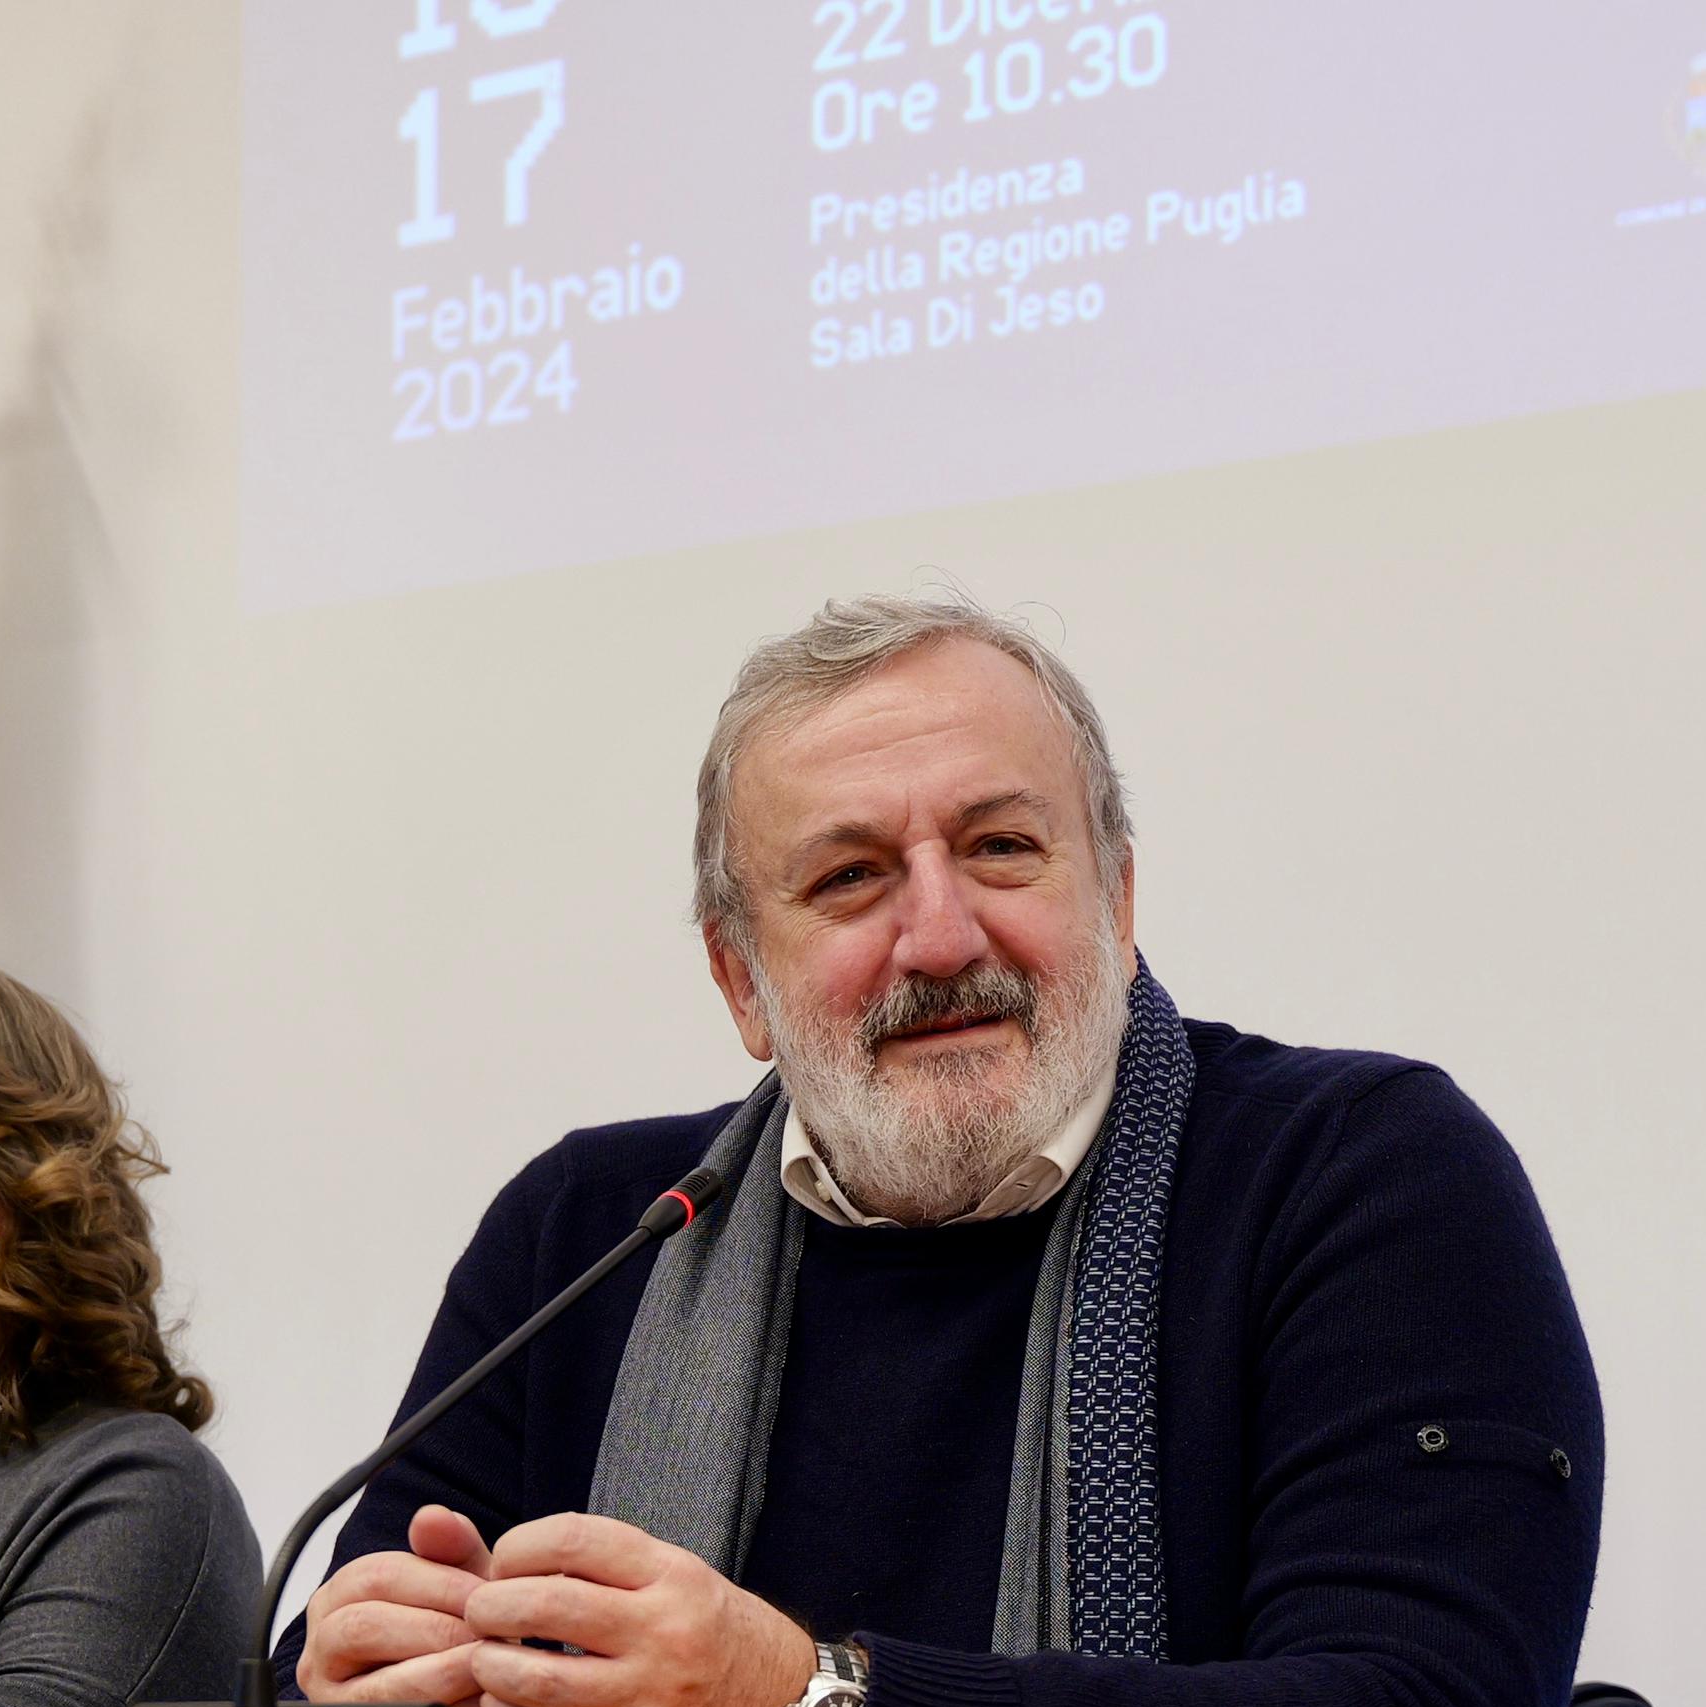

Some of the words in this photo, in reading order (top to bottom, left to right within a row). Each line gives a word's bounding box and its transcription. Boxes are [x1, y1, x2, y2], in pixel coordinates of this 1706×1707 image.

[811, 0, 909, 72] 22
[811, 76, 940, 153] Ore
[961, 10, 1169, 124] 10.30
[396, 57, 566, 248] 17
[809, 155, 1087, 246] Presidenza
[809, 245, 928, 307] della
[938, 211, 1134, 285] Regione
[1145, 169, 1309, 246] Puglia
[390, 243, 685, 363] Febbraio
[809, 310, 916, 369] Sala
[926, 291, 978, 349] Di
[988, 279, 1107, 338] Jeso
[391, 339, 582, 445] 2024
